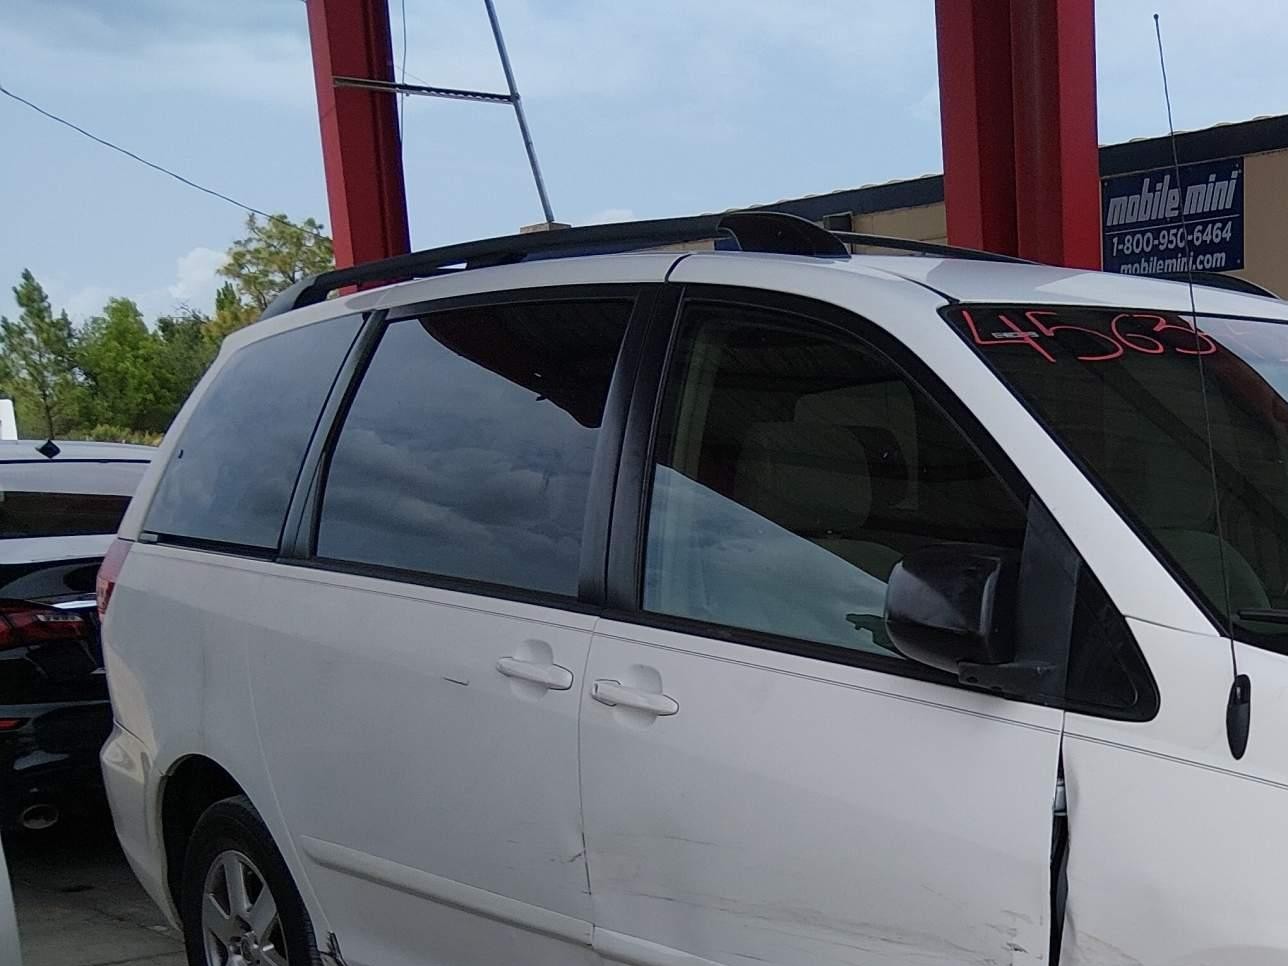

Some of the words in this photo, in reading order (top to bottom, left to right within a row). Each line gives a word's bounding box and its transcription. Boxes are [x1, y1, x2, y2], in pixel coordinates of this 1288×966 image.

[1106, 174, 1180, 226] mobile
[1183, 170, 1239, 215] mini
[1112, 221, 1232, 257] 1-800-950-6464
[1120, 251, 1226, 274] mobilemini.com
